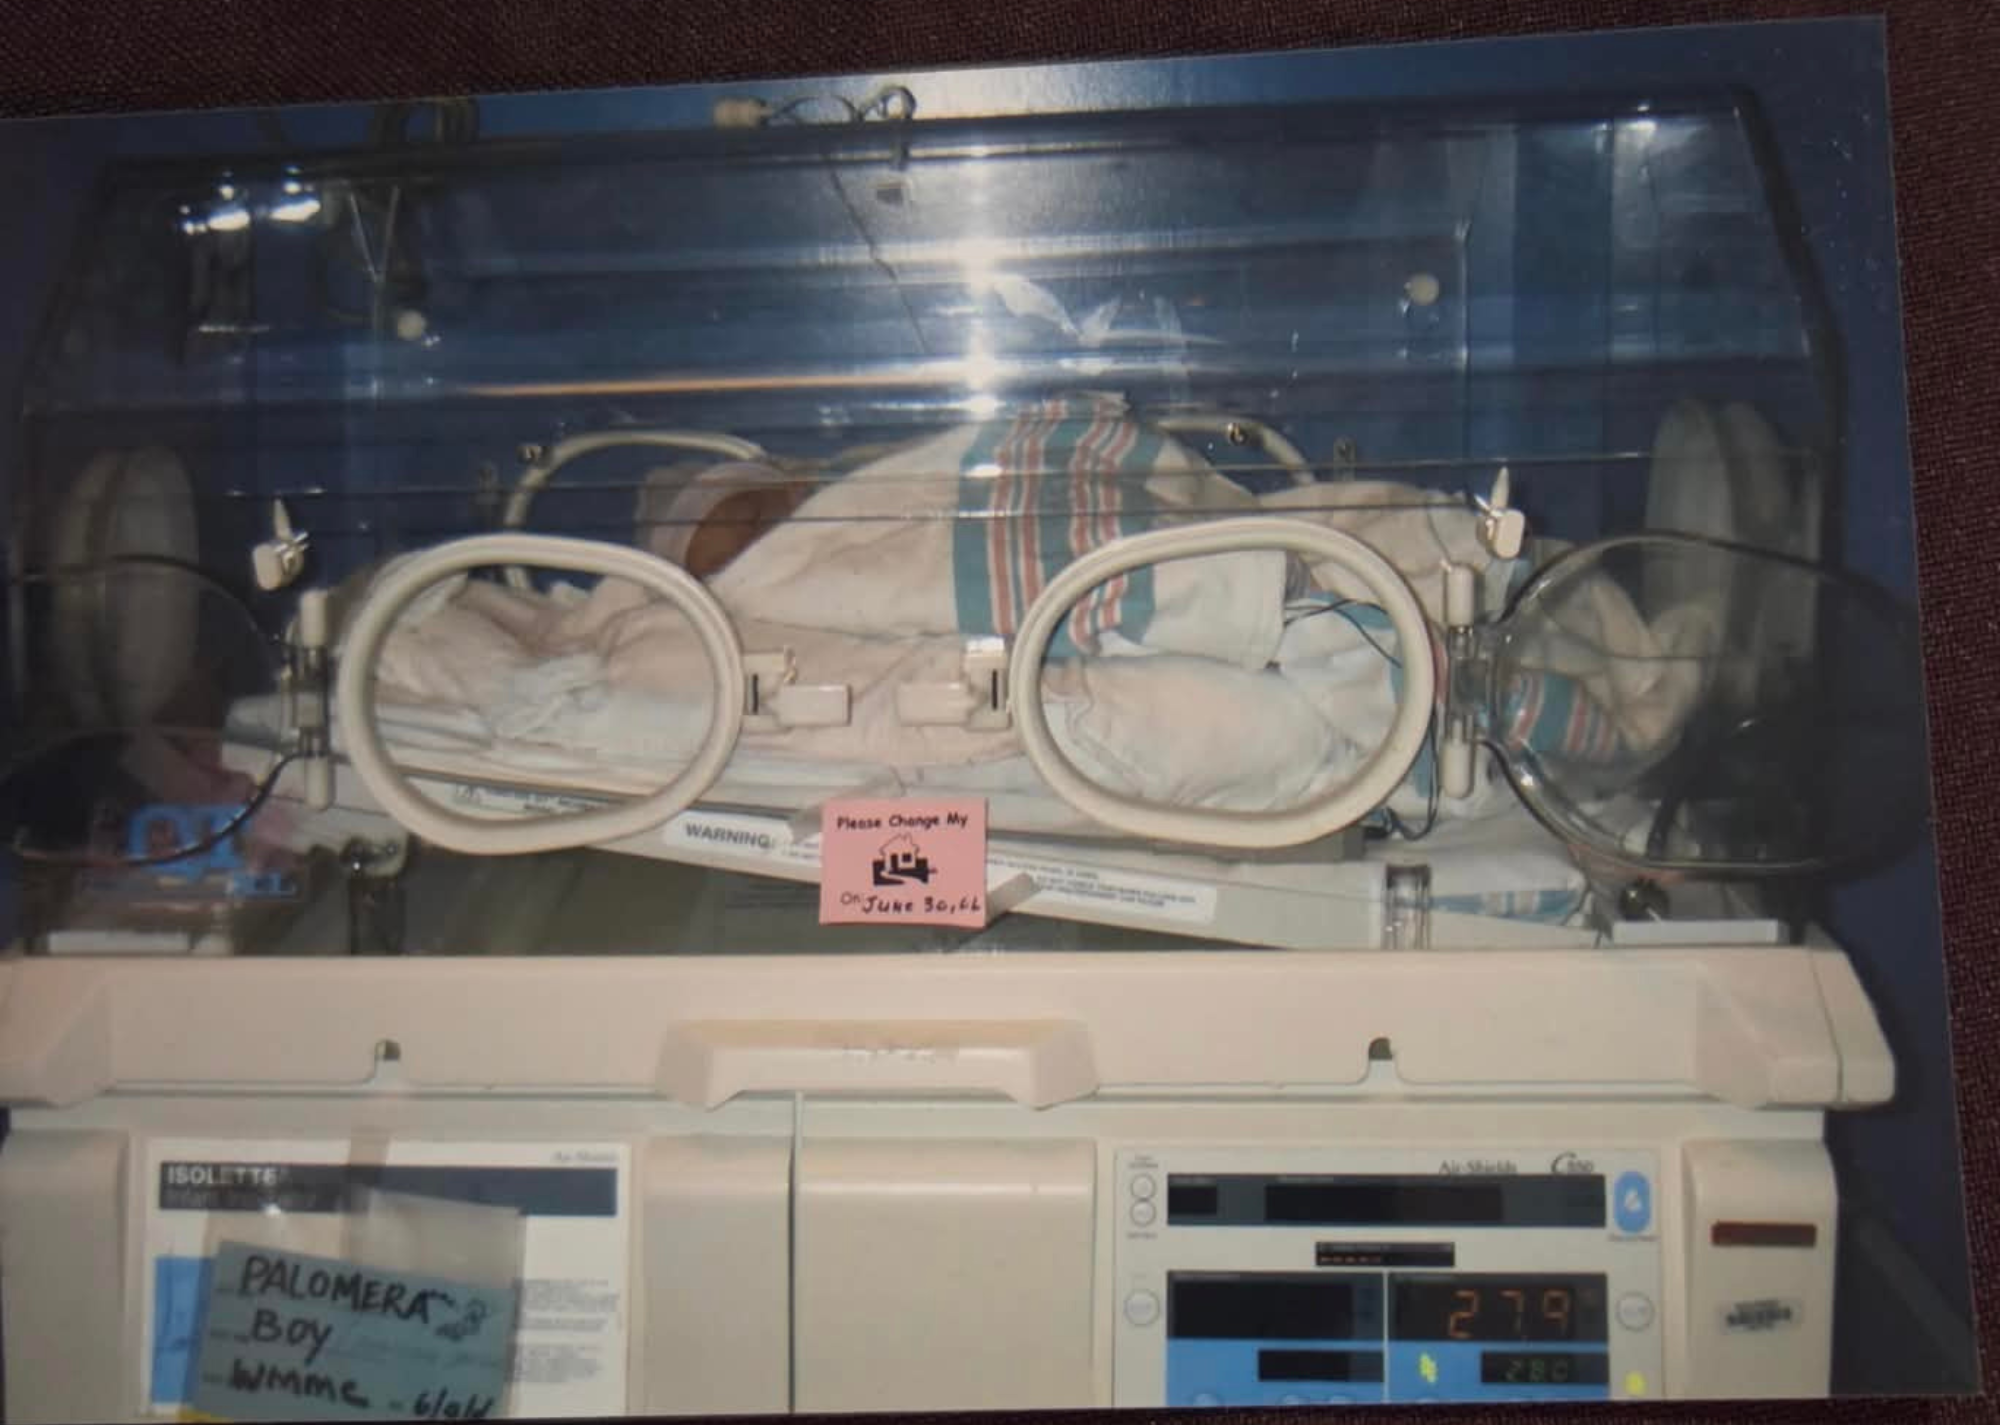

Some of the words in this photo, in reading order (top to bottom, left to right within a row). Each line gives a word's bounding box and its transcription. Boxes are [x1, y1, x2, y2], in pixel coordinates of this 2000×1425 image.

[837, 816, 881, 830] Please
[889, 813, 940, 830] Change
[947, 811, 968, 829] My
